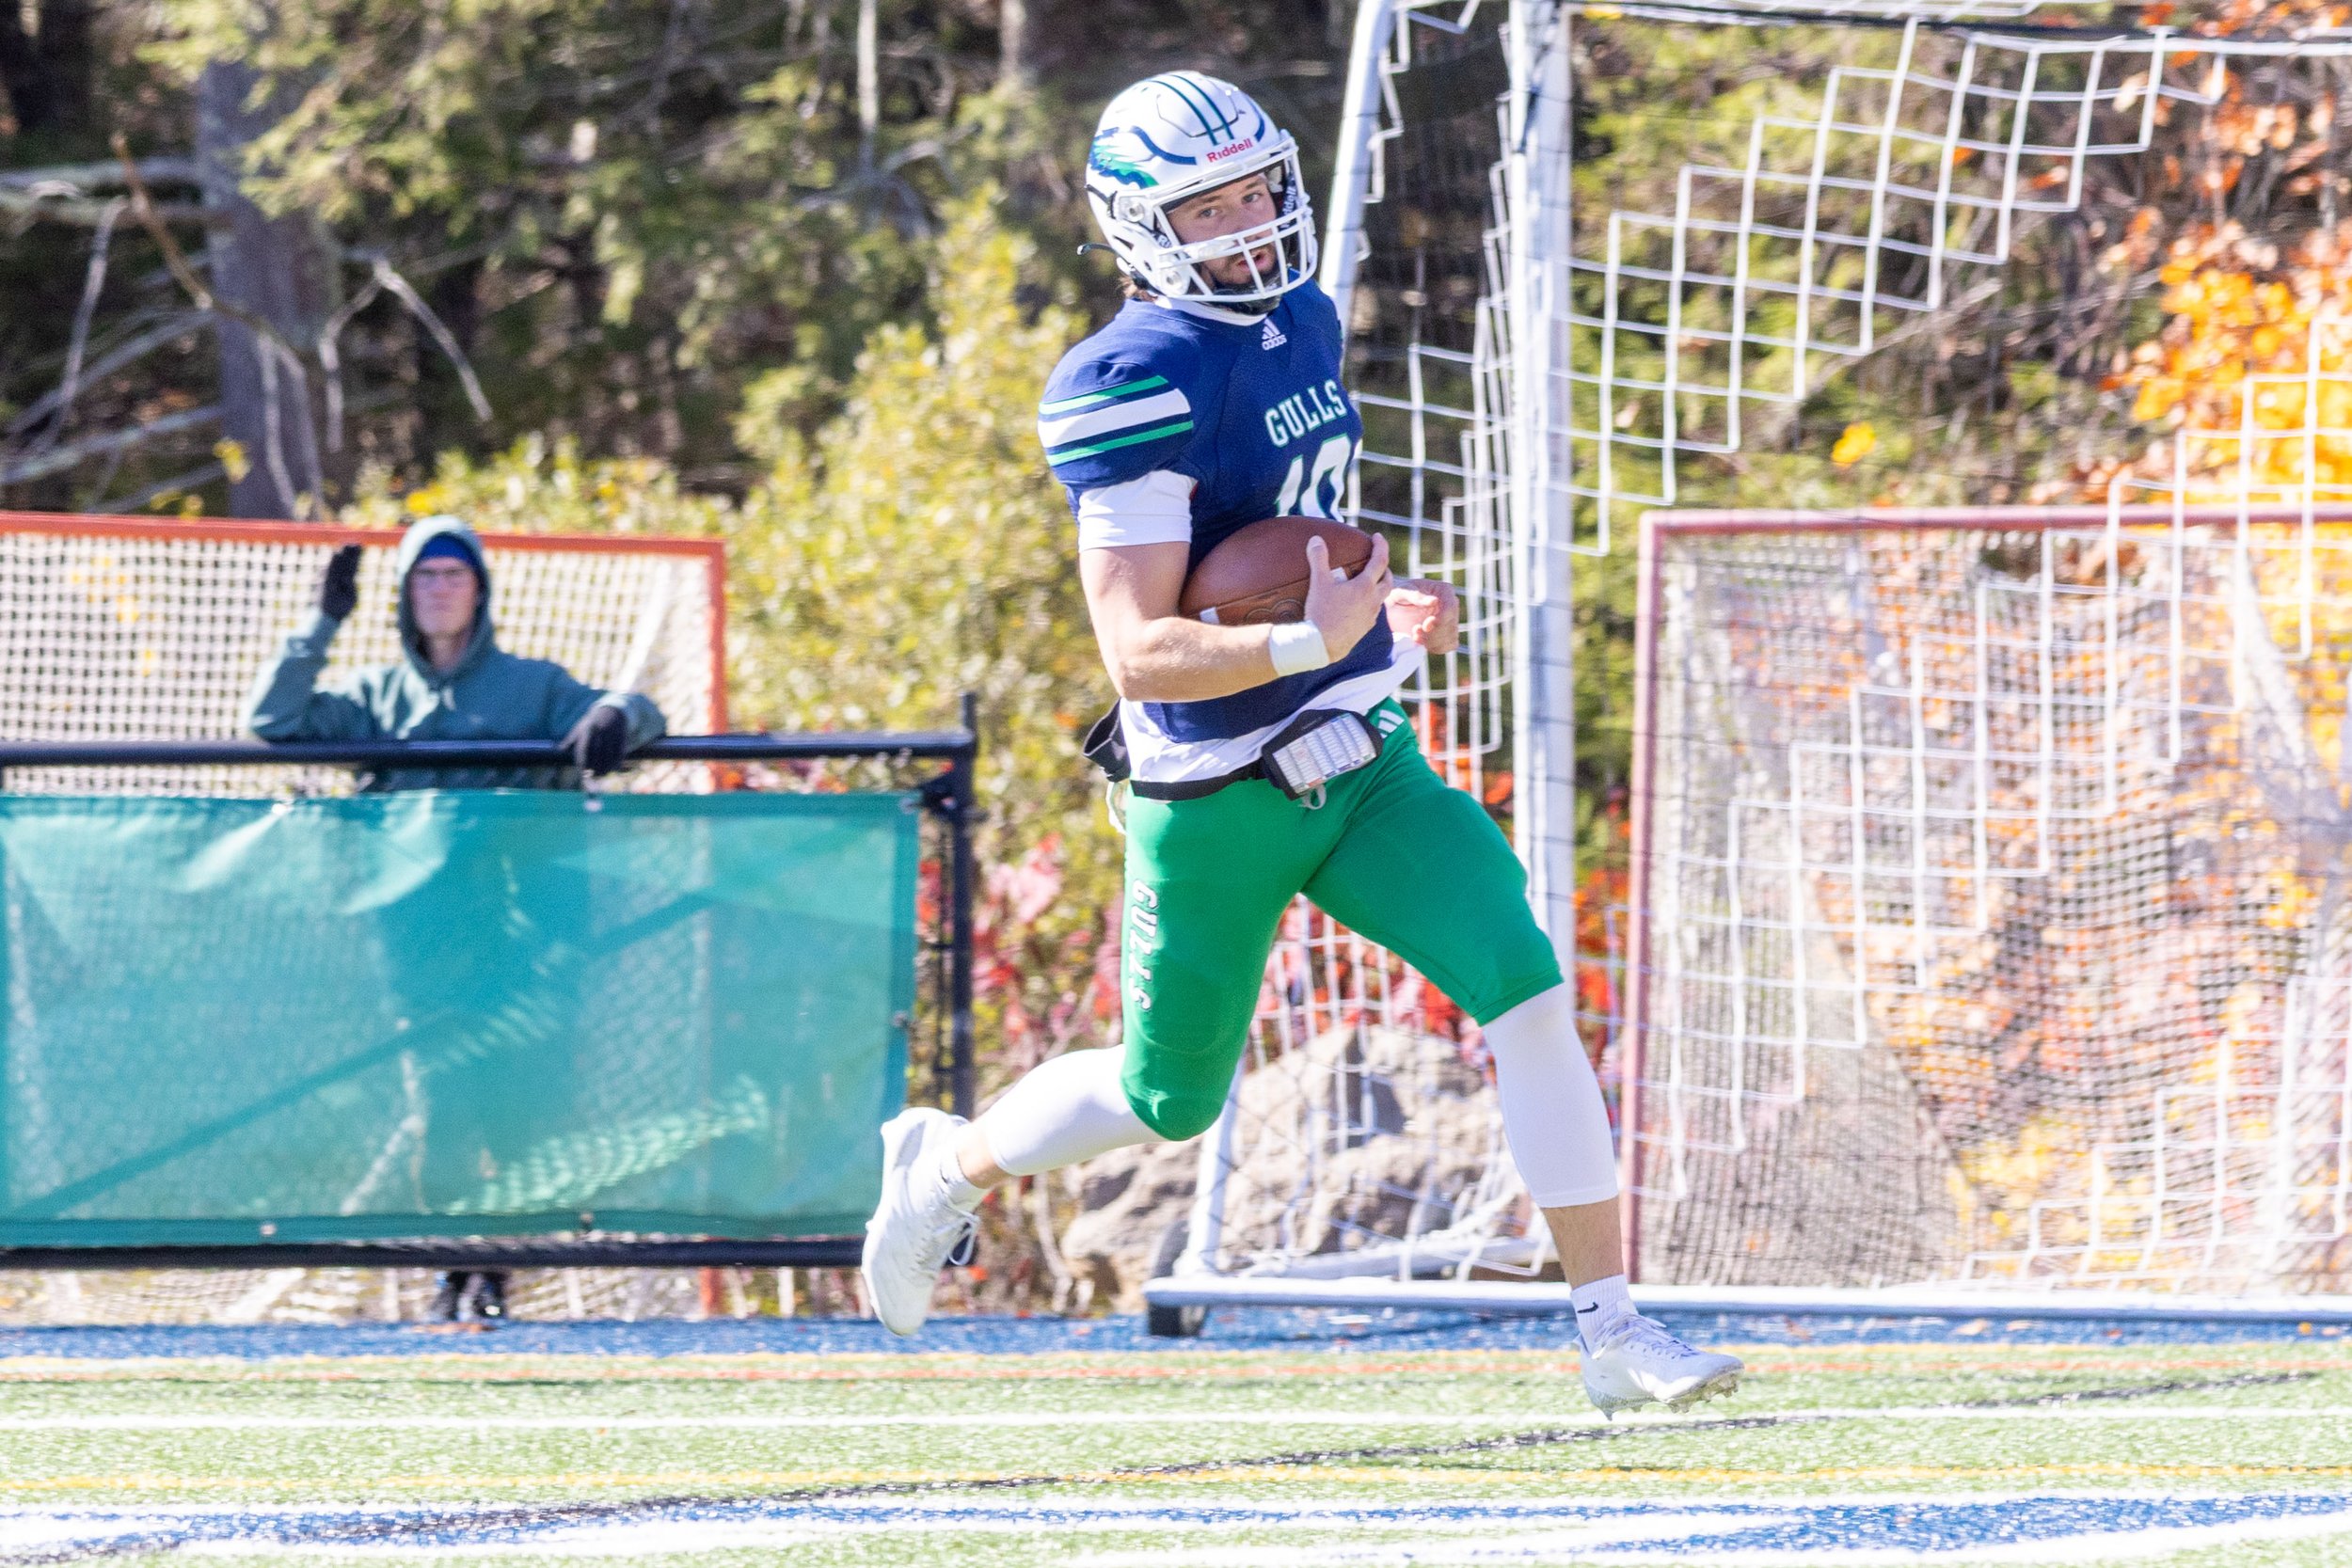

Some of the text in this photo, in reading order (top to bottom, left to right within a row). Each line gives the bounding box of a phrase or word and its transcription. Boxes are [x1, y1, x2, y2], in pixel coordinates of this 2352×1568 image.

[1206, 137, 1253, 163] Riddell
[1263, 378, 1348, 449] GULLS
[1128, 879, 1159, 1011] GULLS
